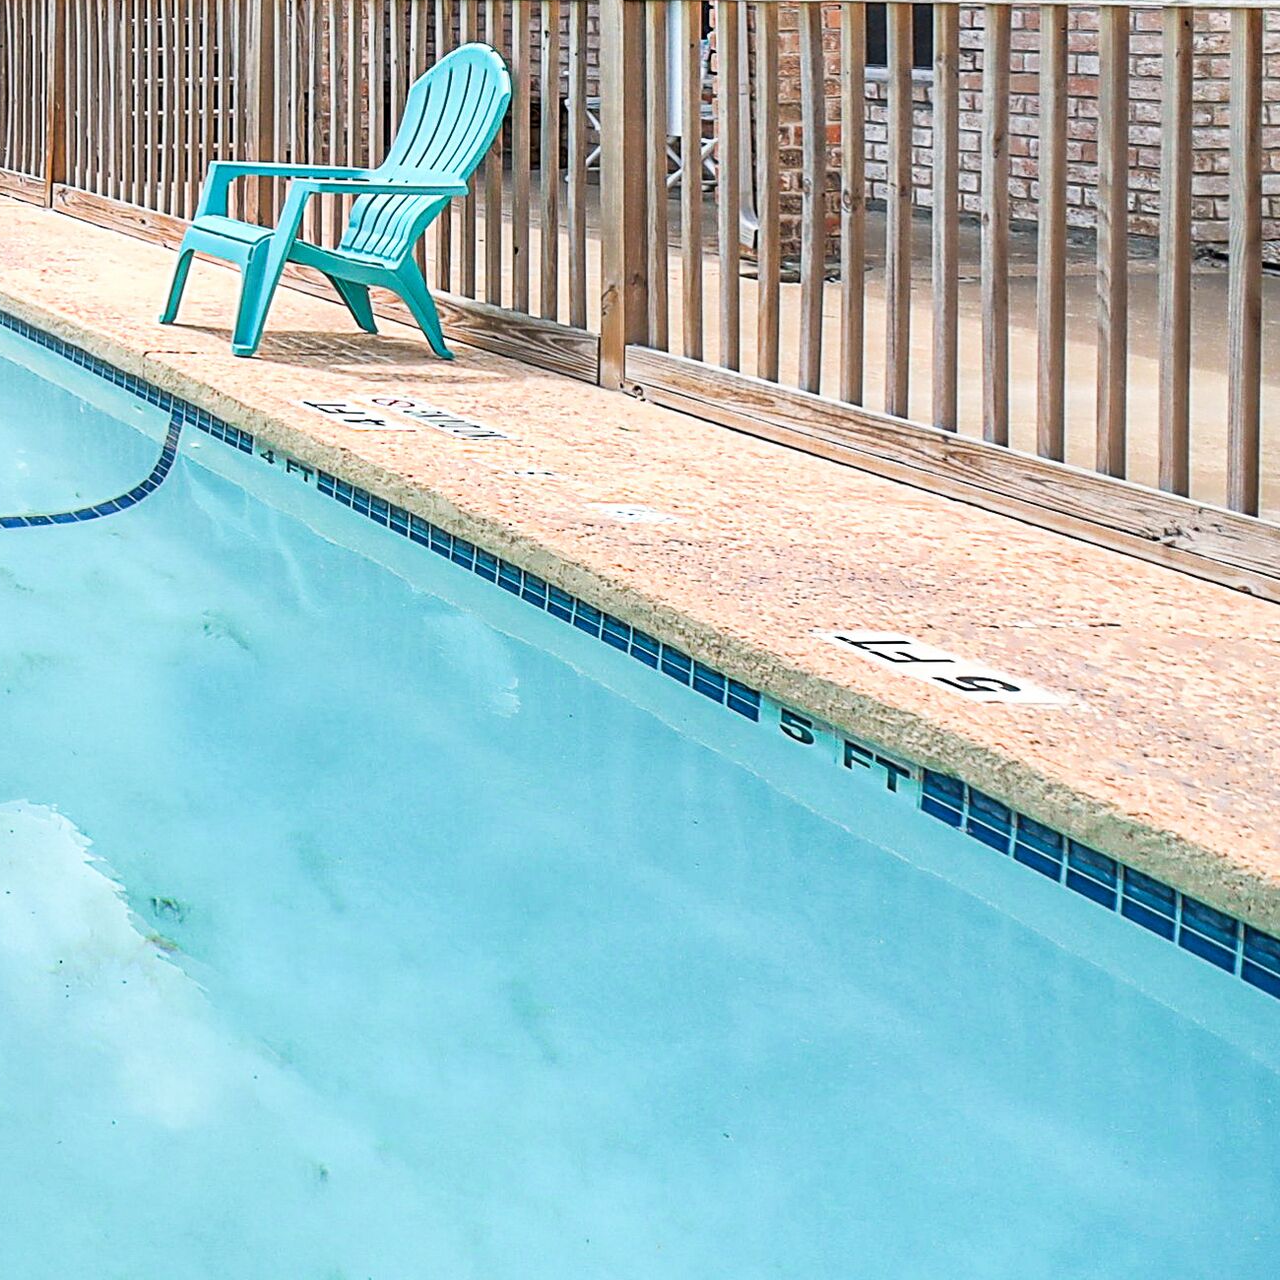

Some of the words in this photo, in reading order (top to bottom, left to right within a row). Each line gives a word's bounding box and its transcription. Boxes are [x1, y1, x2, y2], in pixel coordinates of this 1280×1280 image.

[260, 450, 275, 464] 4
[286, 458, 313, 483] FT
[835, 636, 956, 663] FT
[932, 676, 1021, 692] 5
[779, 707, 815, 735] 5
[843, 739, 911, 793] FT
